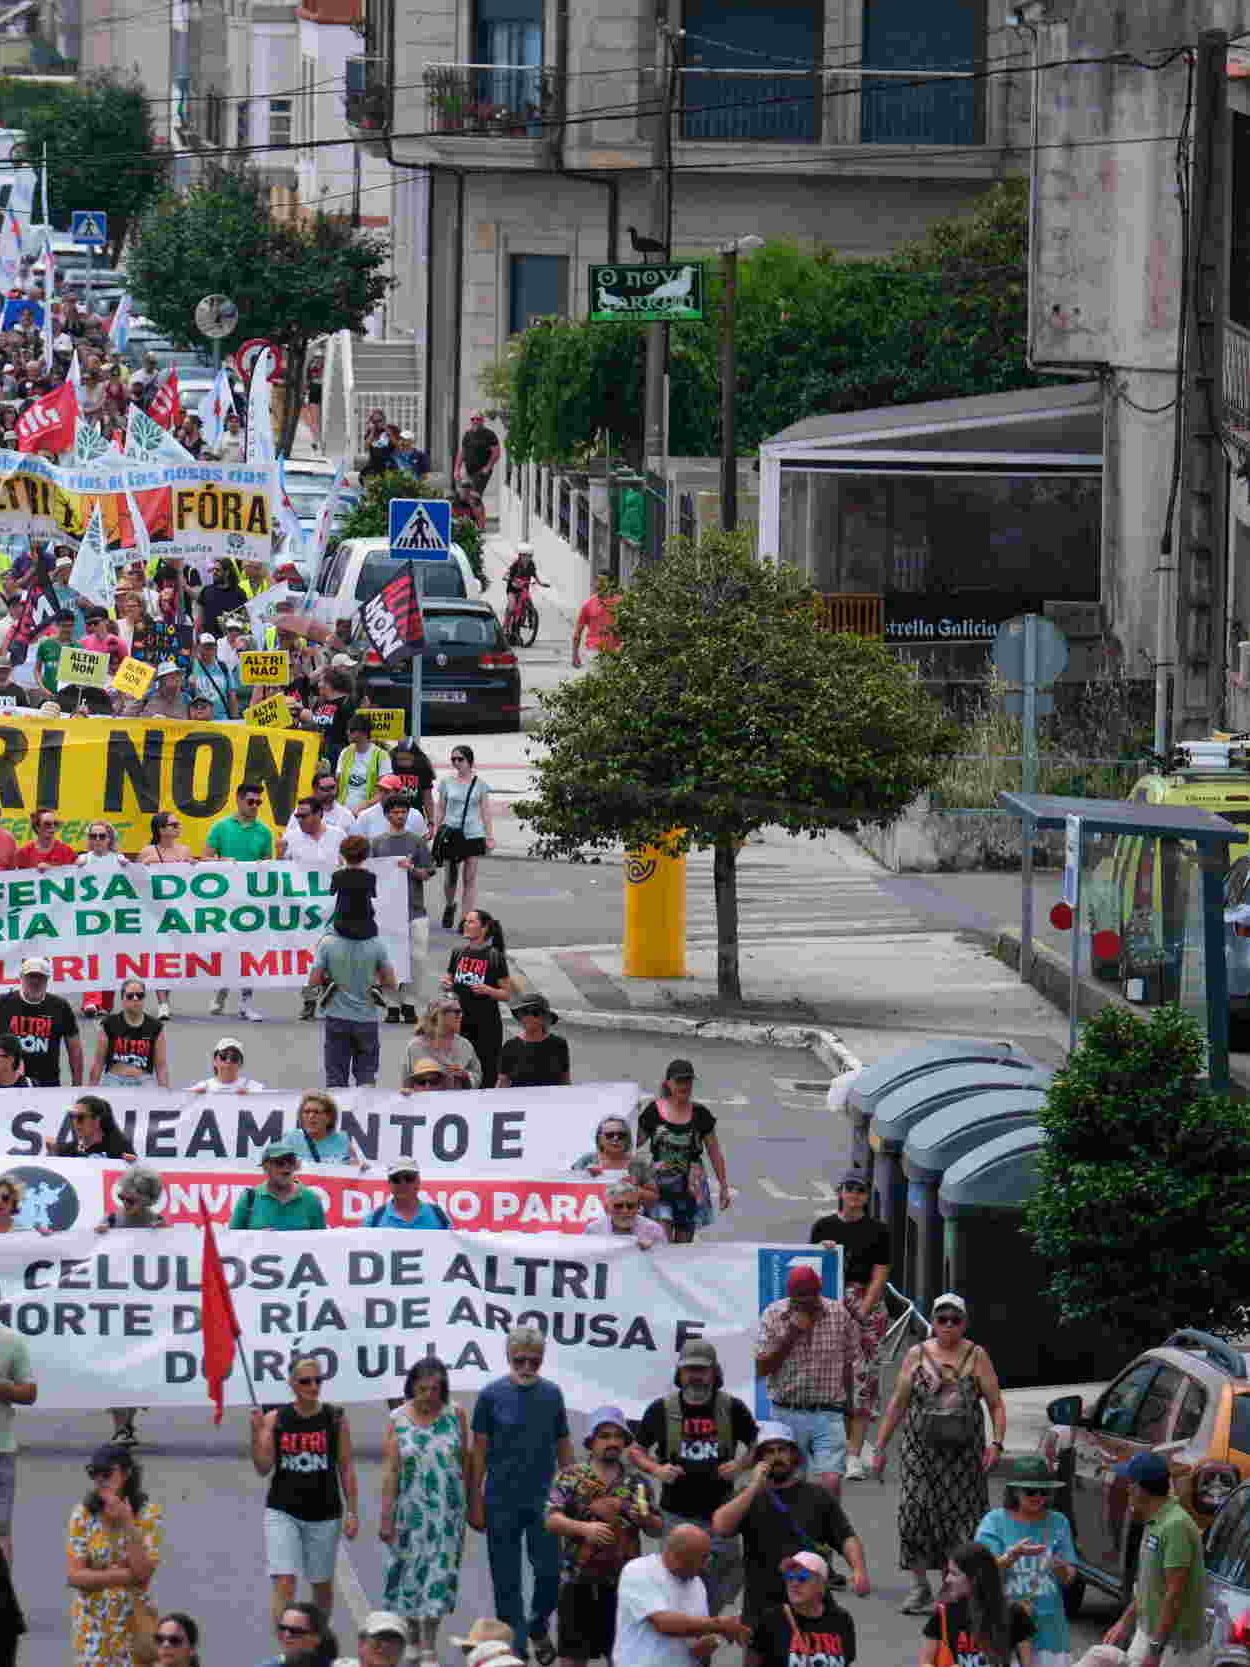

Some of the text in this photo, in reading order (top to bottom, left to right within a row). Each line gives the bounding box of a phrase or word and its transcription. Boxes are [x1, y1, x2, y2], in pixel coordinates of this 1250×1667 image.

[177, 483, 269, 535] FÓRA
[886, 618, 935, 637] strella
[70, 652, 99, 665] ALTRI
[71, 662, 94, 676] NON
[245, 655, 284, 665] ALTRI
[102, 729, 304, 828] NON
[150, 872, 230, 900] DO
[246, 870, 336, 897] ULL
[75, 907, 142, 936] DE
[115, 952, 222, 980] NEN
[490, 1111, 526, 1160] E
[493, 1192, 607, 1223] PARA
[348, 1250, 424, 1286] DE
[442, 1251, 608, 1300] ALTRI
[260, 1290, 348, 1333] RÍA
[364, 1297, 431, 1329] DE
